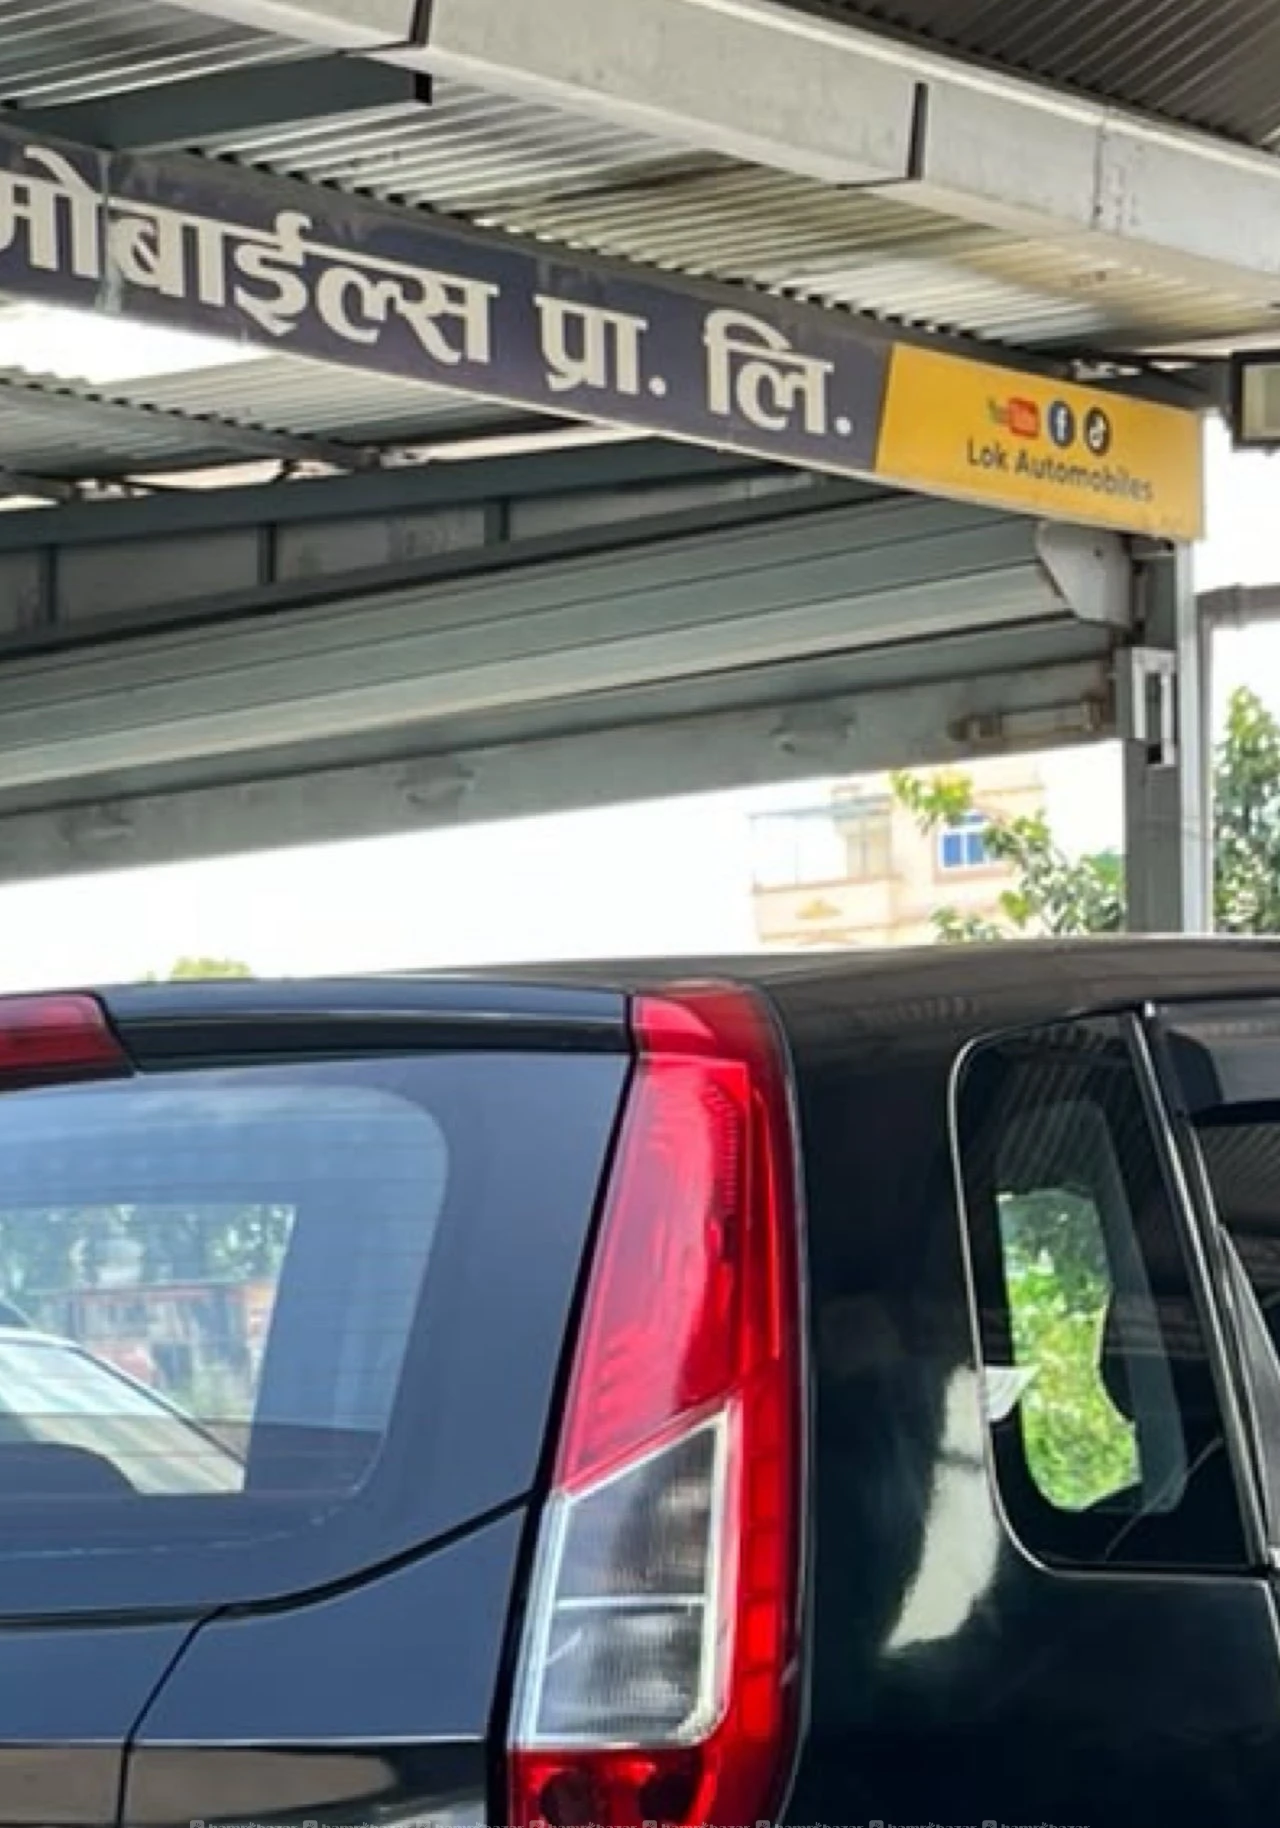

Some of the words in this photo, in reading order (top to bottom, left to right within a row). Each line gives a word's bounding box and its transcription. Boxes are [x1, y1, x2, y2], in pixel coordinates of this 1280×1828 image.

[535, 293, 667, 396] प्रा.
[703, 308, 852, 435] लि.
[967, 437, 1009, 470] Lok
[1015, 450, 1153, 502] Automobiles
